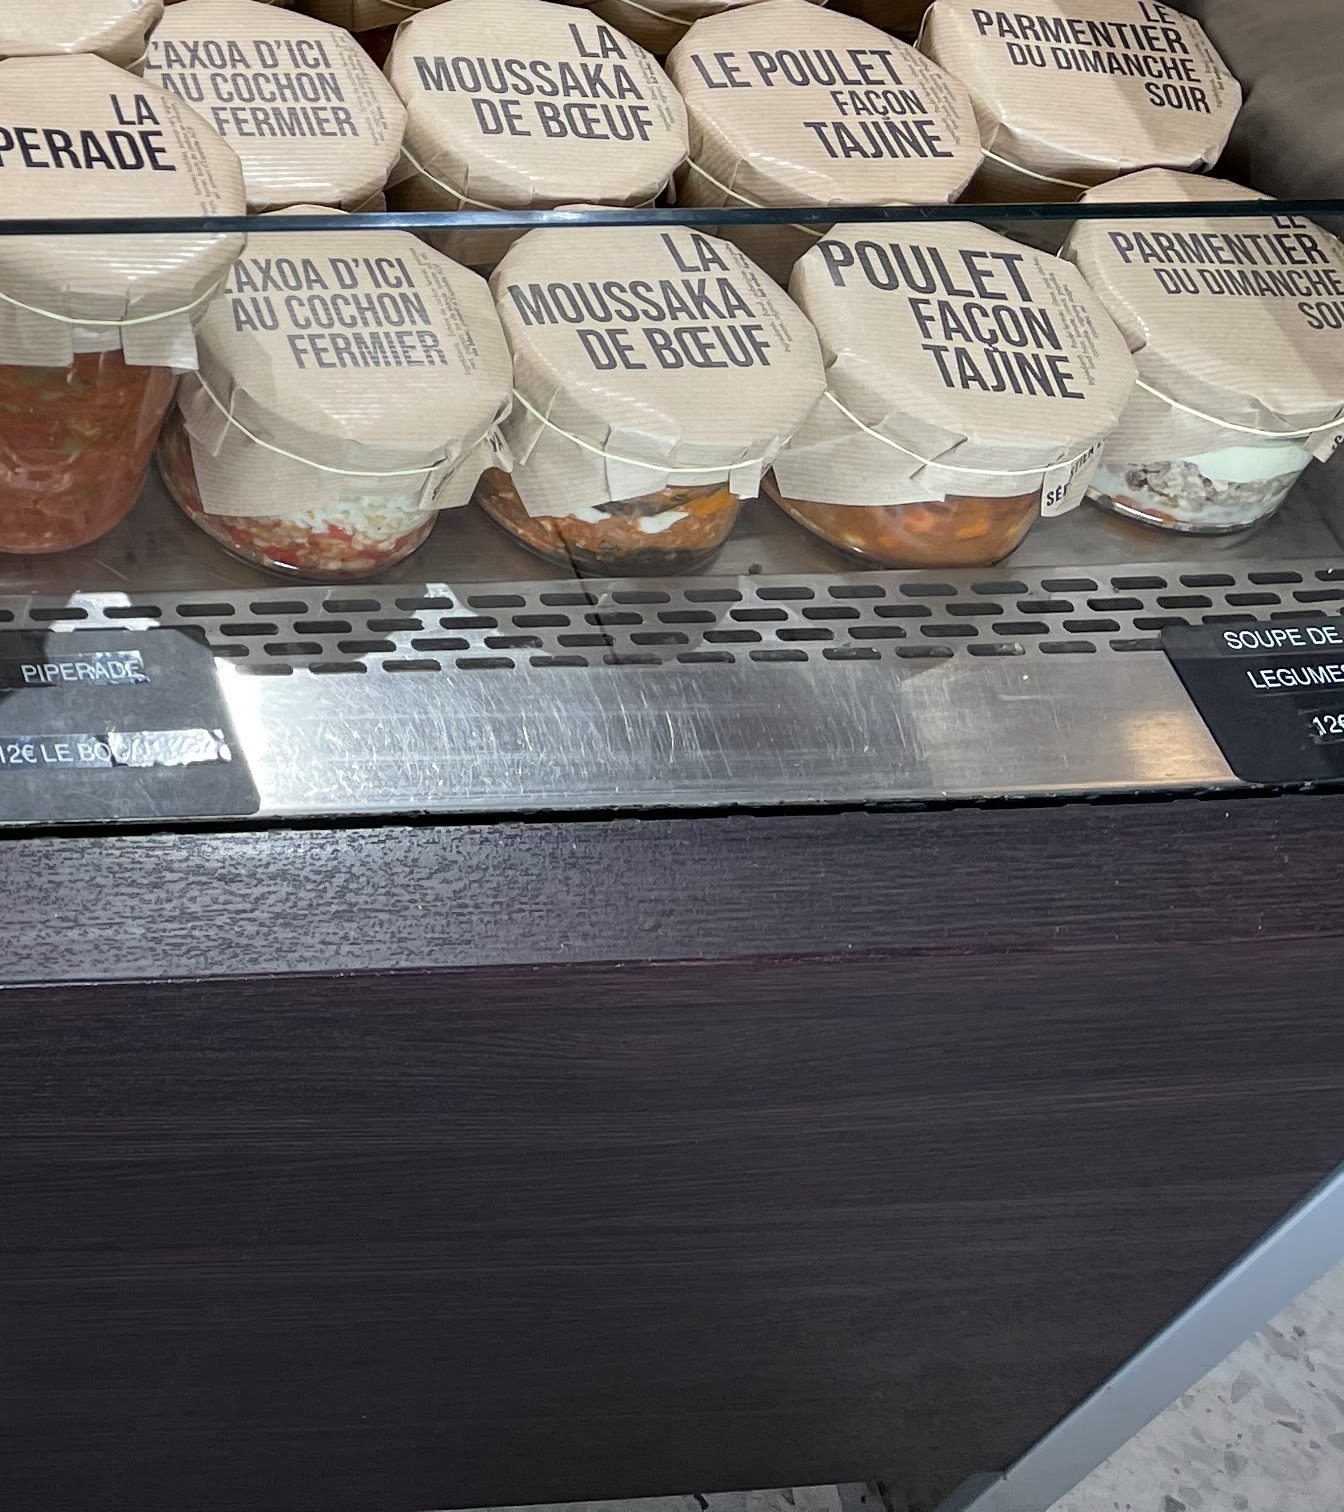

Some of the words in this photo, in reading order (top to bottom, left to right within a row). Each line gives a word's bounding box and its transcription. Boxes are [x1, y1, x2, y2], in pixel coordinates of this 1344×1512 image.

[971, 9, 1190, 55] PARMENTIER
[1138, 1, 1176, 24] LE
[1006, 42, 1047, 67] DU
[1051, 47, 1202, 83] DIMANCHE
[110, 94, 160, 125] LA
[1144, 82, 1212, 114] SOIR
[660, 233, 730, 272] LA
[817, 239, 1034, 302] POULET
[231, 296, 278, 332] AU
[284, 292, 431, 330] COCHON
[507, 277, 756, 326] MOUSSAKA
[908, 296, 1062, 350] FAÇON
[286, 330, 448, 369] FERMIER
[576, 328, 647, 370] DE
[641, 324, 770, 369] BŒUF
[921, 343, 1085, 399] TAJINE
[1224, 629, 1306, 649] SOUPE
[1306, 626, 1343, 644] DE
[21, 660, 145, 683] PIPERADE
[1247, 665, 1344, 688] LEGUME
[40, 744, 70, 762] LE
